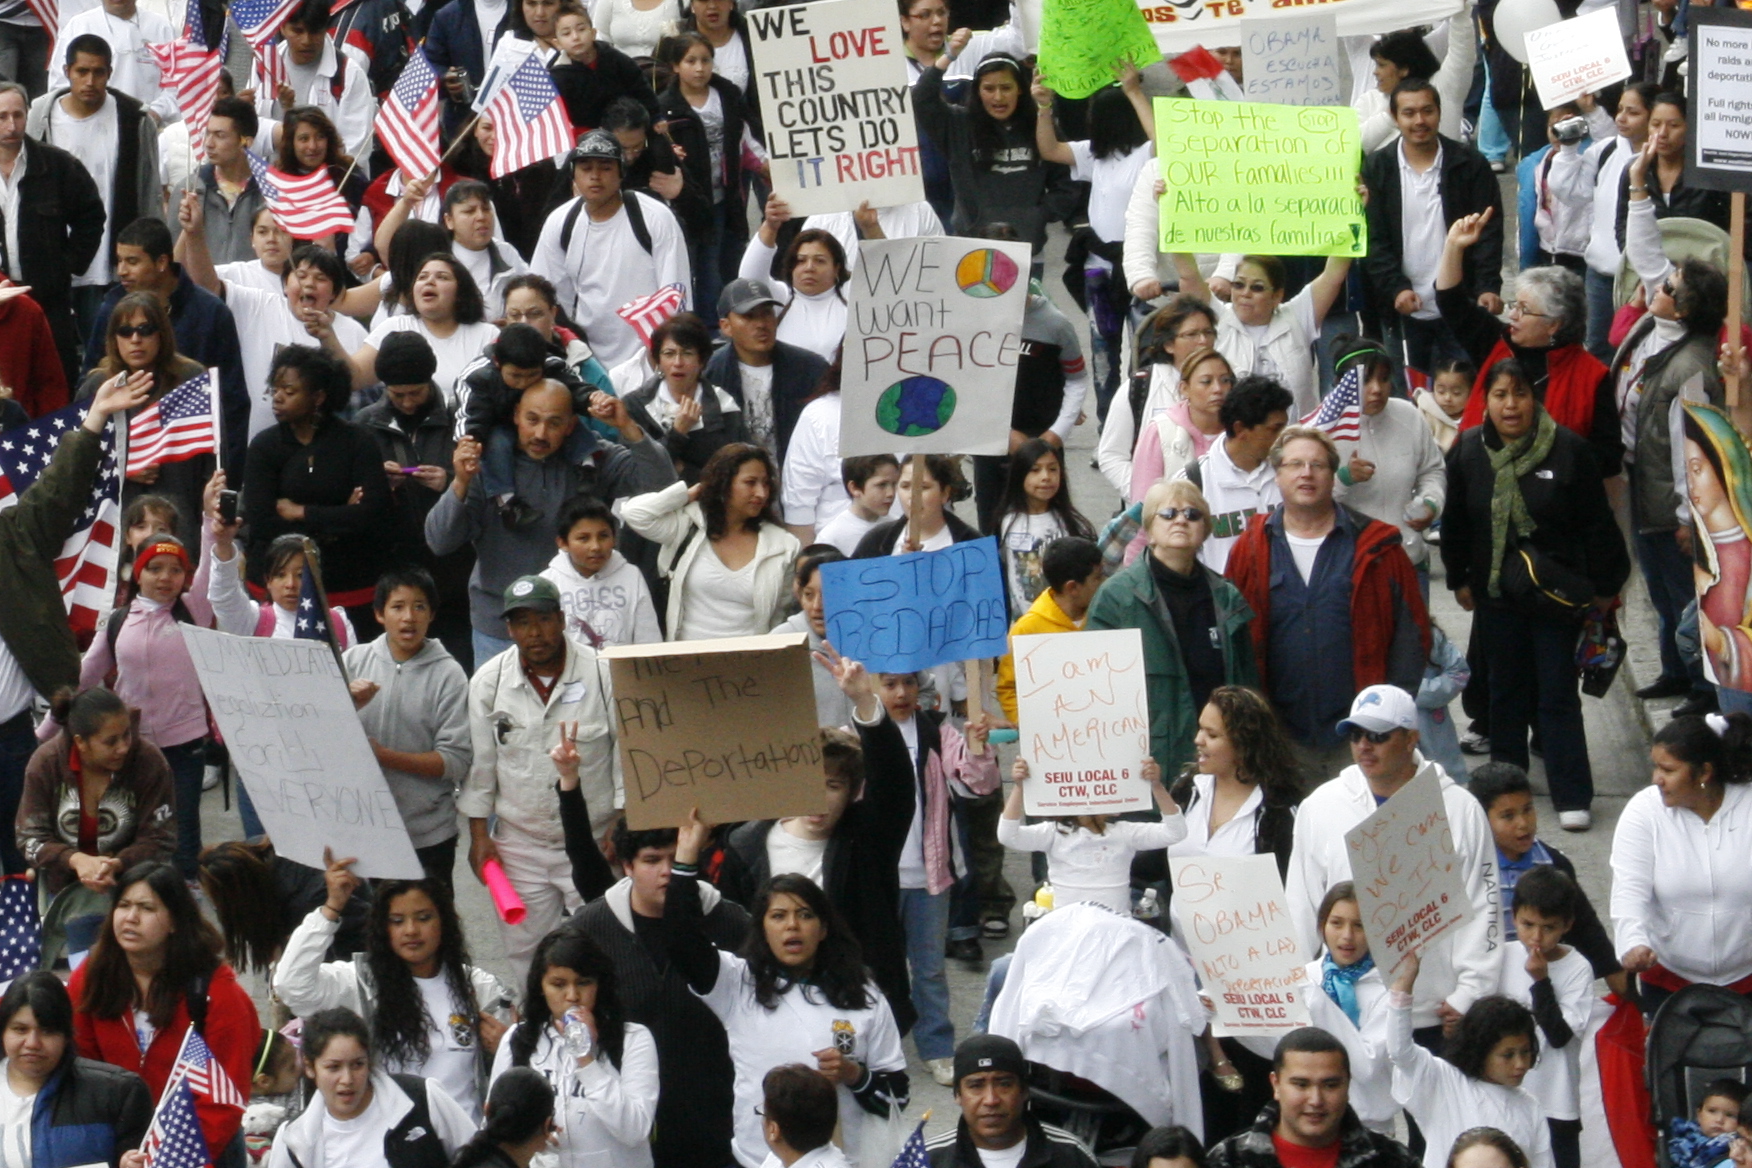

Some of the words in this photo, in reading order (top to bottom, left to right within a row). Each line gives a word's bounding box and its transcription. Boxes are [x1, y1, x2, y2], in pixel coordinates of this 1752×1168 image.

[751, 6, 812, 42] WE
[1249, 26, 1326, 55] OBAMA
[809, 26, 891, 65] LOVE
[1706, 38, 1720, 47] No
[1723, 41, 1748, 50] more
[1718, 56, 1742, 66] raids
[763, 64, 837, 101] THIS
[1266, 57, 1337, 74] ESCUCHA
[1248, 76, 1334, 94] ESTAMOS
[1708, 97, 1725, 107] Full
[777, 85, 914, 129] COUNTRY
[1171, 101, 1224, 131] Stop
[1233, 105, 1280, 131] the
[1704, 113, 1716, 121] all
[767, 124, 846, 161] LETS
[861, 117, 899, 149] DO
[1168, 133, 1309, 158] separation
[1324, 130, 1352, 154] of
[796, 156, 825, 190] IT
[836, 145, 920, 185] RIGHT
[1168, 161, 1219, 186] OUR
[1175, 190, 1219, 213] Alto
[1227, 198, 1240, 212] a
[1248, 192, 1265, 214] la
[1165, 223, 1186, 245] de
[1195, 223, 1262, 242] nuestras
[858, 240, 941, 299] WE
[854, 297, 953, 336] want
[862, 329, 1021, 382] PEACE
[853, 545, 988, 605] STOP
[826, 597, 1008, 663] REDADAS
[1021, 638, 1054, 698] I
[1062, 652, 1138, 680] am
[692, 675, 760, 709] The
[1053, 689, 1115, 718] AN
[1045, 772, 1073, 784] SEIU
[1078, 769, 1117, 782] LOCAL
[1121, 769, 1129, 779] 6
[1059, 785, 1090, 798] CTW,
[1094, 784, 1117, 796] CLC
[1193, 900, 1286, 945] OBAMA
[1385, 924, 1406, 948] SEIU
[1407, 900, 1439, 928] LOCAL
[1440, 892, 1448, 904] 6
[1482, 862, 1498, 953] NAUTICA
[1397, 930, 1421, 952] CTW,
[1422, 912, 1442, 932] CLC
[1201, 952, 1239, 982] ALTO
[1247, 946, 1260, 962] A
[1223, 992, 1245, 1004] SEIU
[1247, 992, 1282, 1004] LOCAL
[1286, 991, 1294, 1004] 6
[1238, 1006, 1264, 1020] CTW,
[1265, 1006, 1287, 1018] CLC
